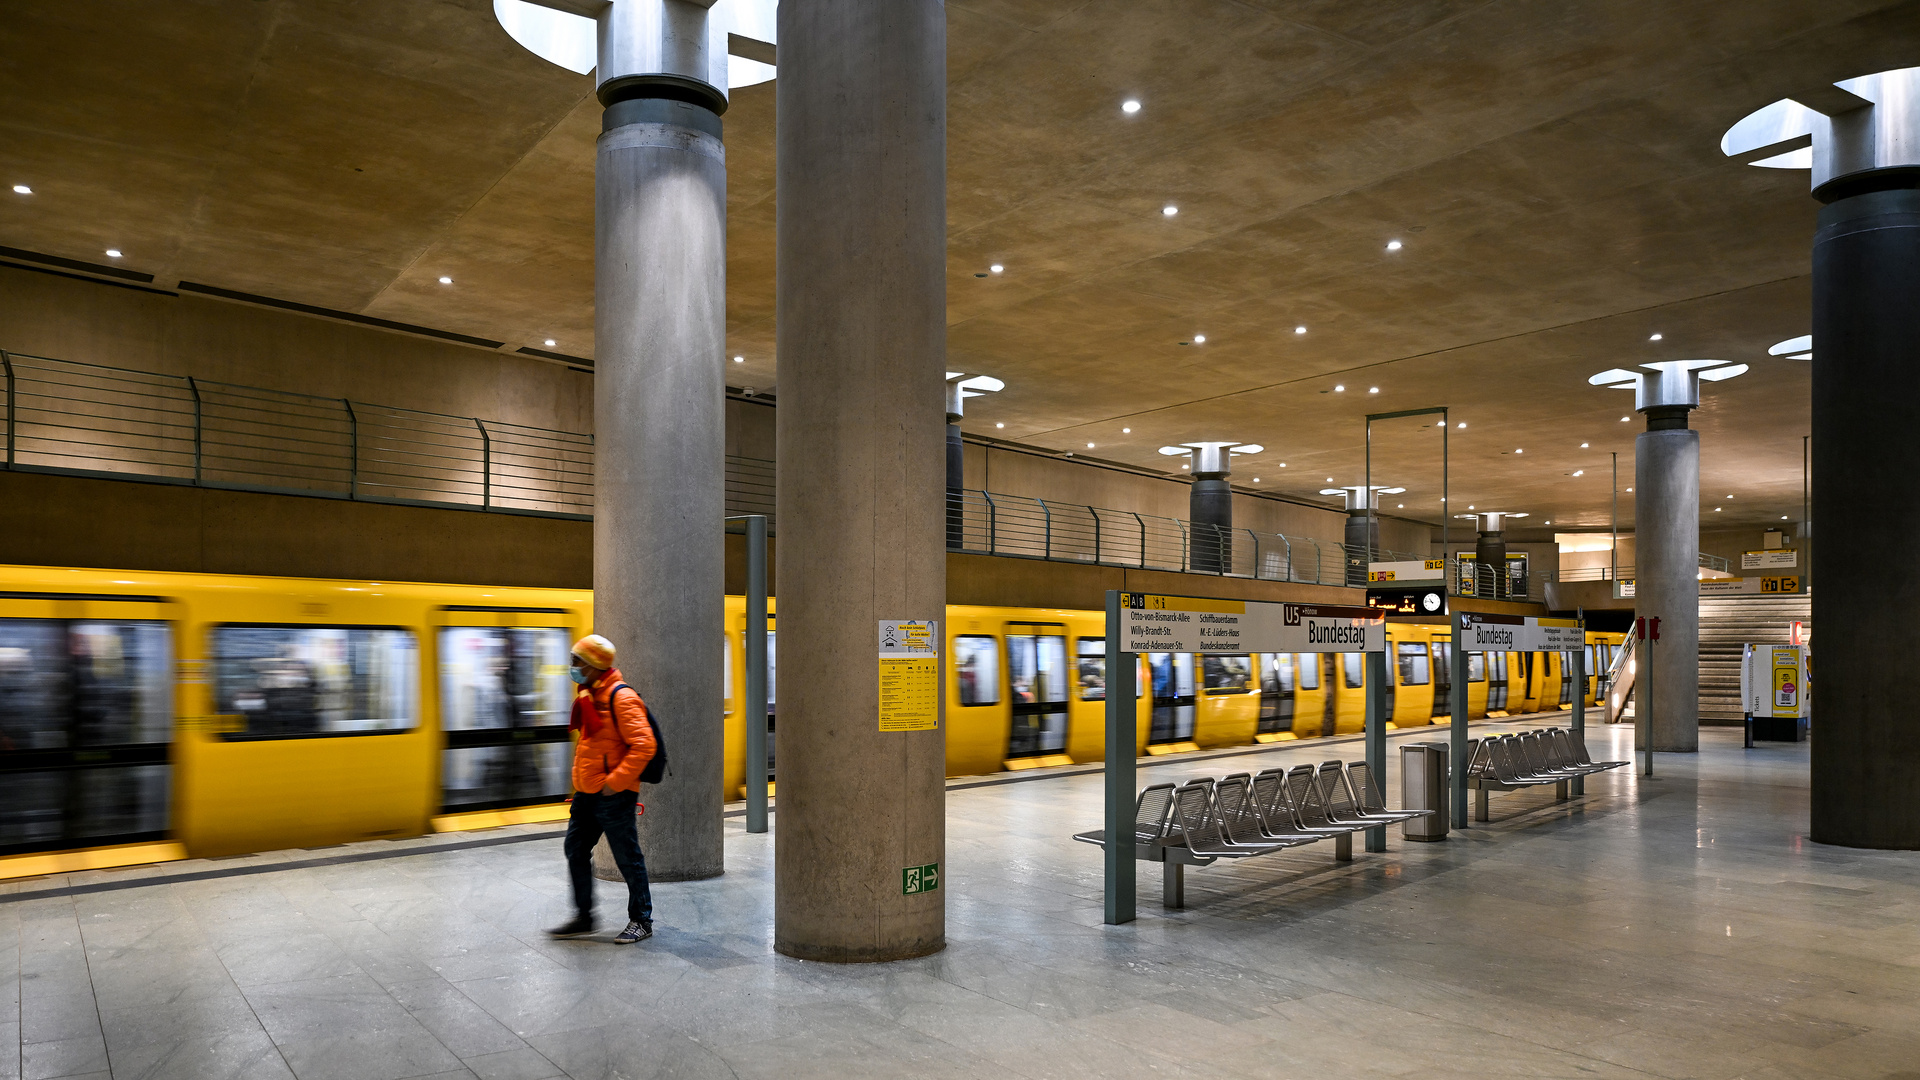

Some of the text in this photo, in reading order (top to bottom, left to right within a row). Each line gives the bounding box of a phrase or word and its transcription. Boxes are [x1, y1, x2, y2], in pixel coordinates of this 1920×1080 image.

[1131, 596, 1136, 606] A
[1139, 597, 1144, 606] B
[1130, 611, 1190, 622] Otto-von-Bismarck-Allee
[1200, 614, 1238, 624] Schiffbauerdamm
[1286, 606, 1300, 624] U5
[1461, 614, 1470, 628] U5
[1130, 626, 1172, 637] Willy-Brandt-Str.
[1200, 628, 1240, 637] M.-E.-Lüders-Haus
[1308, 619, 1365, 650] Bundestag
[1476, 625, 1512, 650] Bundestag
[1130, 640, 1184, 650] Konrad-Adenauer-Str.
[1200, 641, 1240, 650] Bundeskanzleramt
